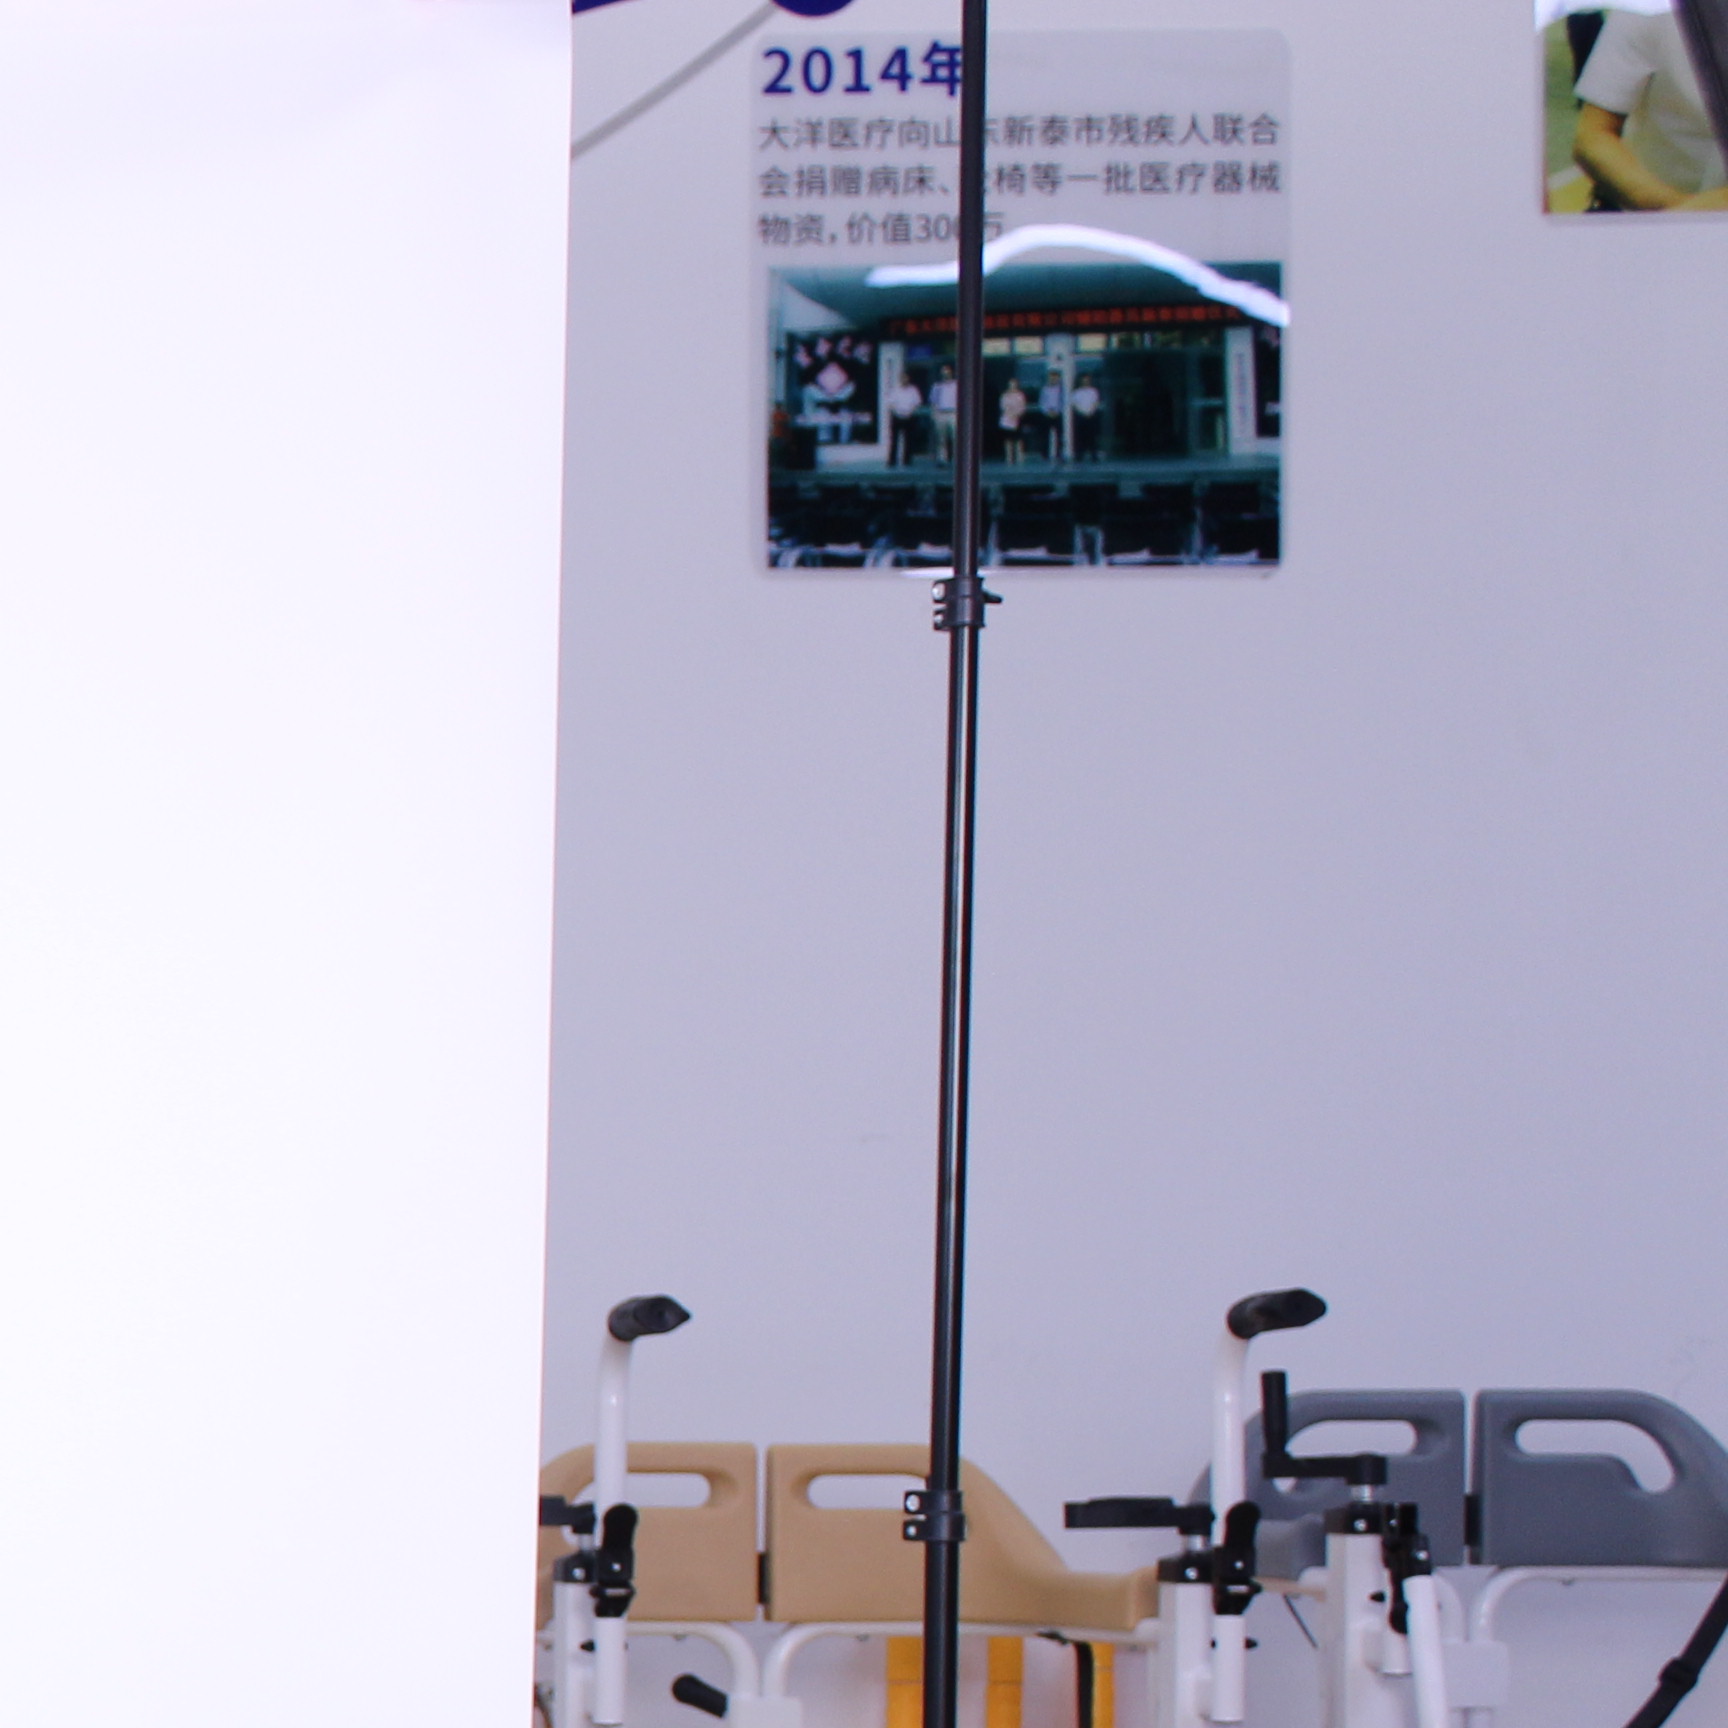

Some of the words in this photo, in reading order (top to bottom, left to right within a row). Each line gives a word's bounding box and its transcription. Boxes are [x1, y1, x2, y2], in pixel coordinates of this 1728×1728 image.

[762, 39, 962, 97] 2014年
[758, 163, 1282, 197] 会捐赠病床、椅等一批医疗器械
